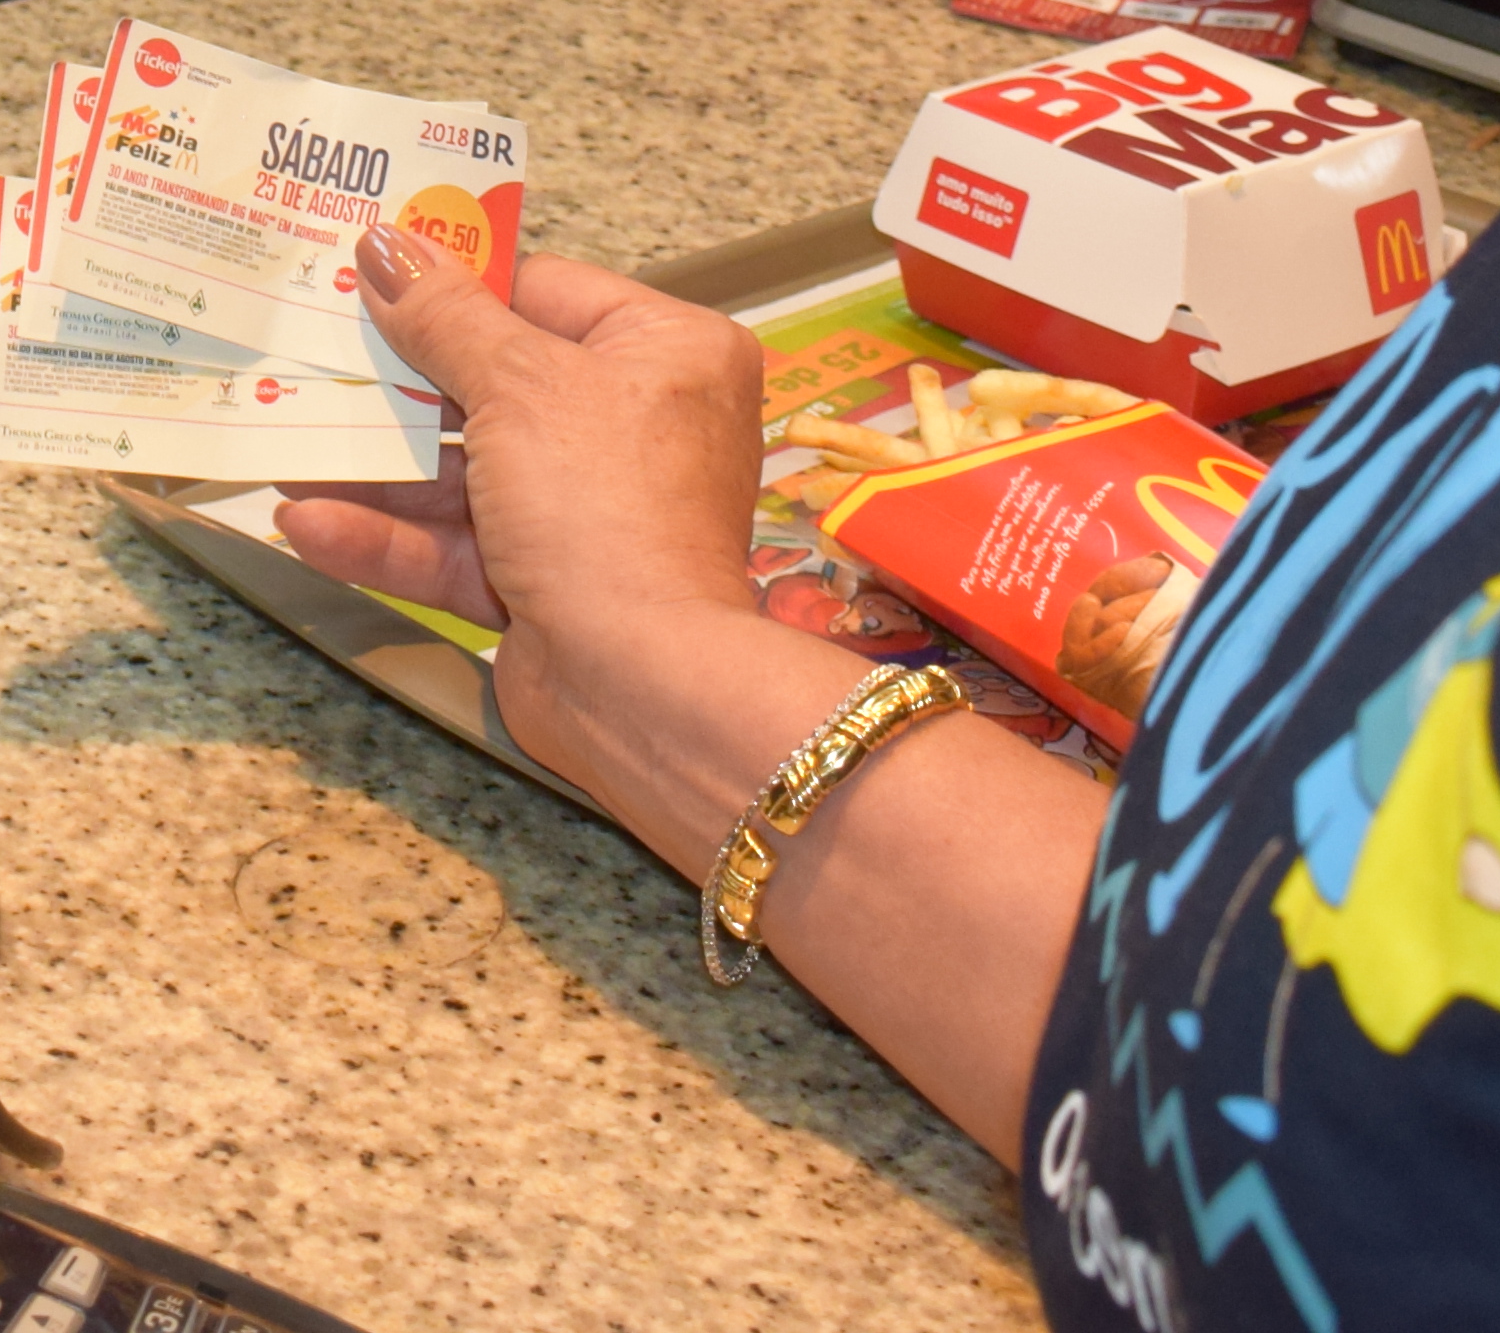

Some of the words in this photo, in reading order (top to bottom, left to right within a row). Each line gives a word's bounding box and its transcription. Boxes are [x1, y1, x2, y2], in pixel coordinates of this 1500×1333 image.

[135, 46, 183, 77] Ticket
[75, 90, 97, 108] Tic
[943, 51, 1253, 144] Big
[121, 110, 199, 152] McDia
[1059, 86, 1414, 192] Mac
[114, 134, 172, 169] Feliz
[261, 117, 390, 197] SÁBADO
[105, 181, 129, 195] VÁLIDO
[130, 188, 163, 208] SOMENTE
[107, 163, 122, 180] 30
[123, 170, 149, 189] ANOS
[150, 176, 230, 215] TRANSFORMANDO
[231, 202, 247, 220] BIG
[277, 219, 293, 234] EM
[292, 223, 340, 247] SORRISOS
[254, 171, 278, 202] 25
[281, 179, 307, 211] DE
[307, 188, 381, 228] AGOSTO
[936, 171, 969, 197] amo
[970, 182, 1015, 215] muito
[936, 191, 970, 217] tudo
[971, 204, 1005, 230] isso
[85, 257, 124, 282] THOMAS
[125, 269, 151, 290] GREG
[163, 284, 189, 303] SONS
[97, 279, 109, 289] do
[112, 281, 141, 299] Brasil
[51, 305, 92, 324] THOMAS
[93, 312, 121, 326] GREG
[134, 318, 160, 333] SONS
[67, 323, 79, 332] do
[82, 324, 111, 338] Brasil
[7, 343, 31, 356] VÁLIDO
[32, 345, 67, 359] SOMENTE
[68, 348, 80, 359] NO
[80, 349, 93, 360] DIA
[104, 352, 115, 363] DE
[115, 352, 145, 365] AGOSTO
[145, 355, 156, 367] DE
[819, 341, 880, 372] 25
[767, 368, 821, 393] de
[1, 424, 42, 441] THOMAS
[44, 429, 72, 443] GREG
[85, 433, 112, 447] SONS
[17, 442, 30, 451] do
[33, 441, 63, 454] Brasil
[960, 566, 978, 595] Para
[1017, 571, 1036, 591] Do
[1033, 585, 1051, 621] amo
[1046, 540, 1071, 584] muito
[1062, 512, 1089, 542] tudo
[144, 1312, 179, 1333] 3
